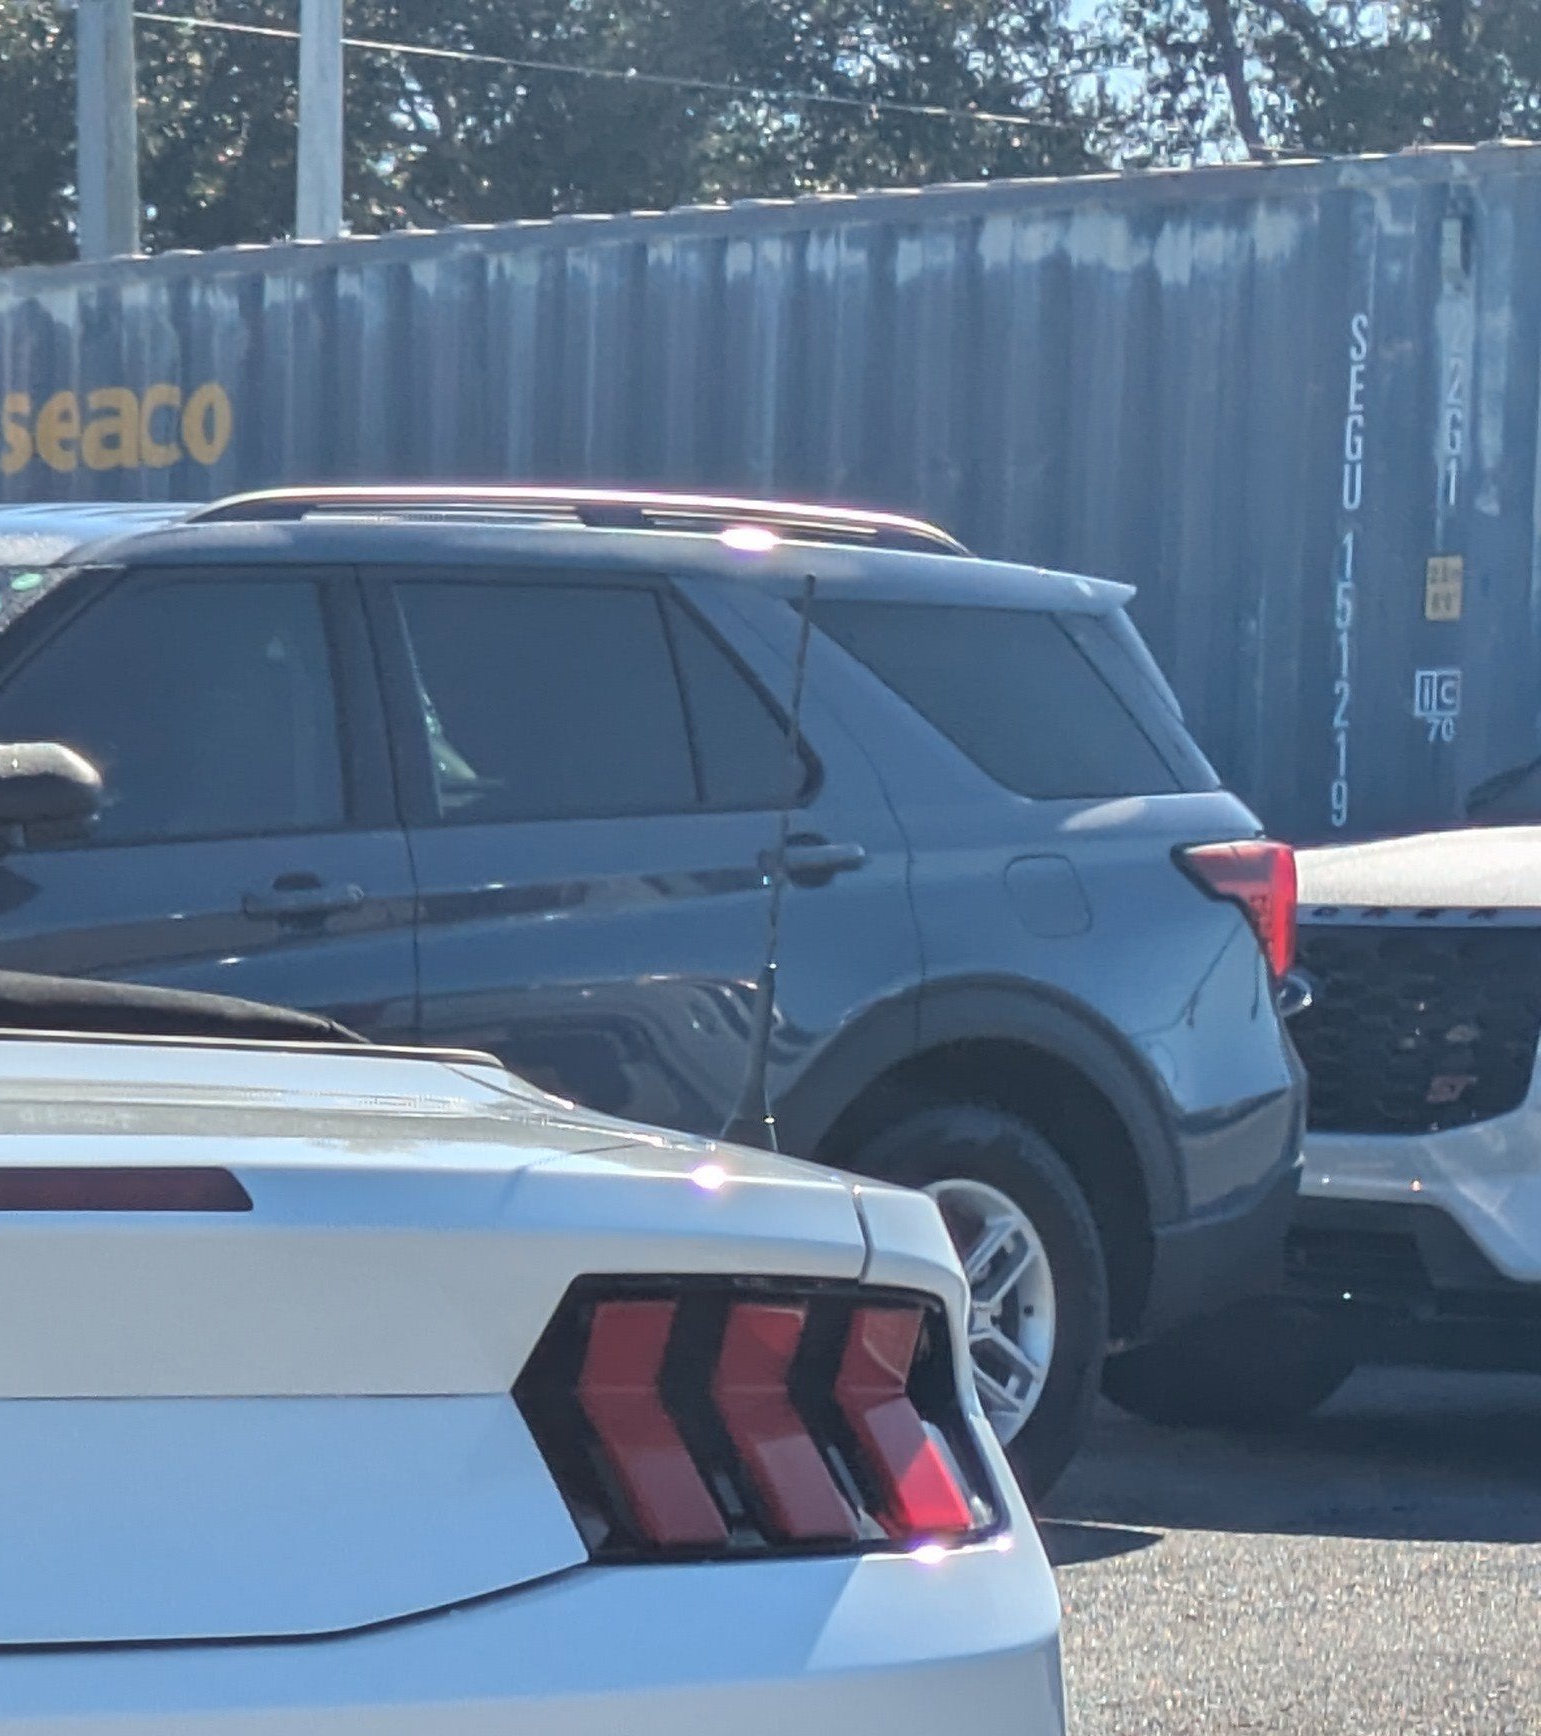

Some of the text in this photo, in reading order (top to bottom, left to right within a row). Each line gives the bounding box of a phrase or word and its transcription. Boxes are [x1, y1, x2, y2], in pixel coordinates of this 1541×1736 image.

[1331, 313, 1368, 827] SEGU 151219
[1445, 304, 1466, 506] 2G1
